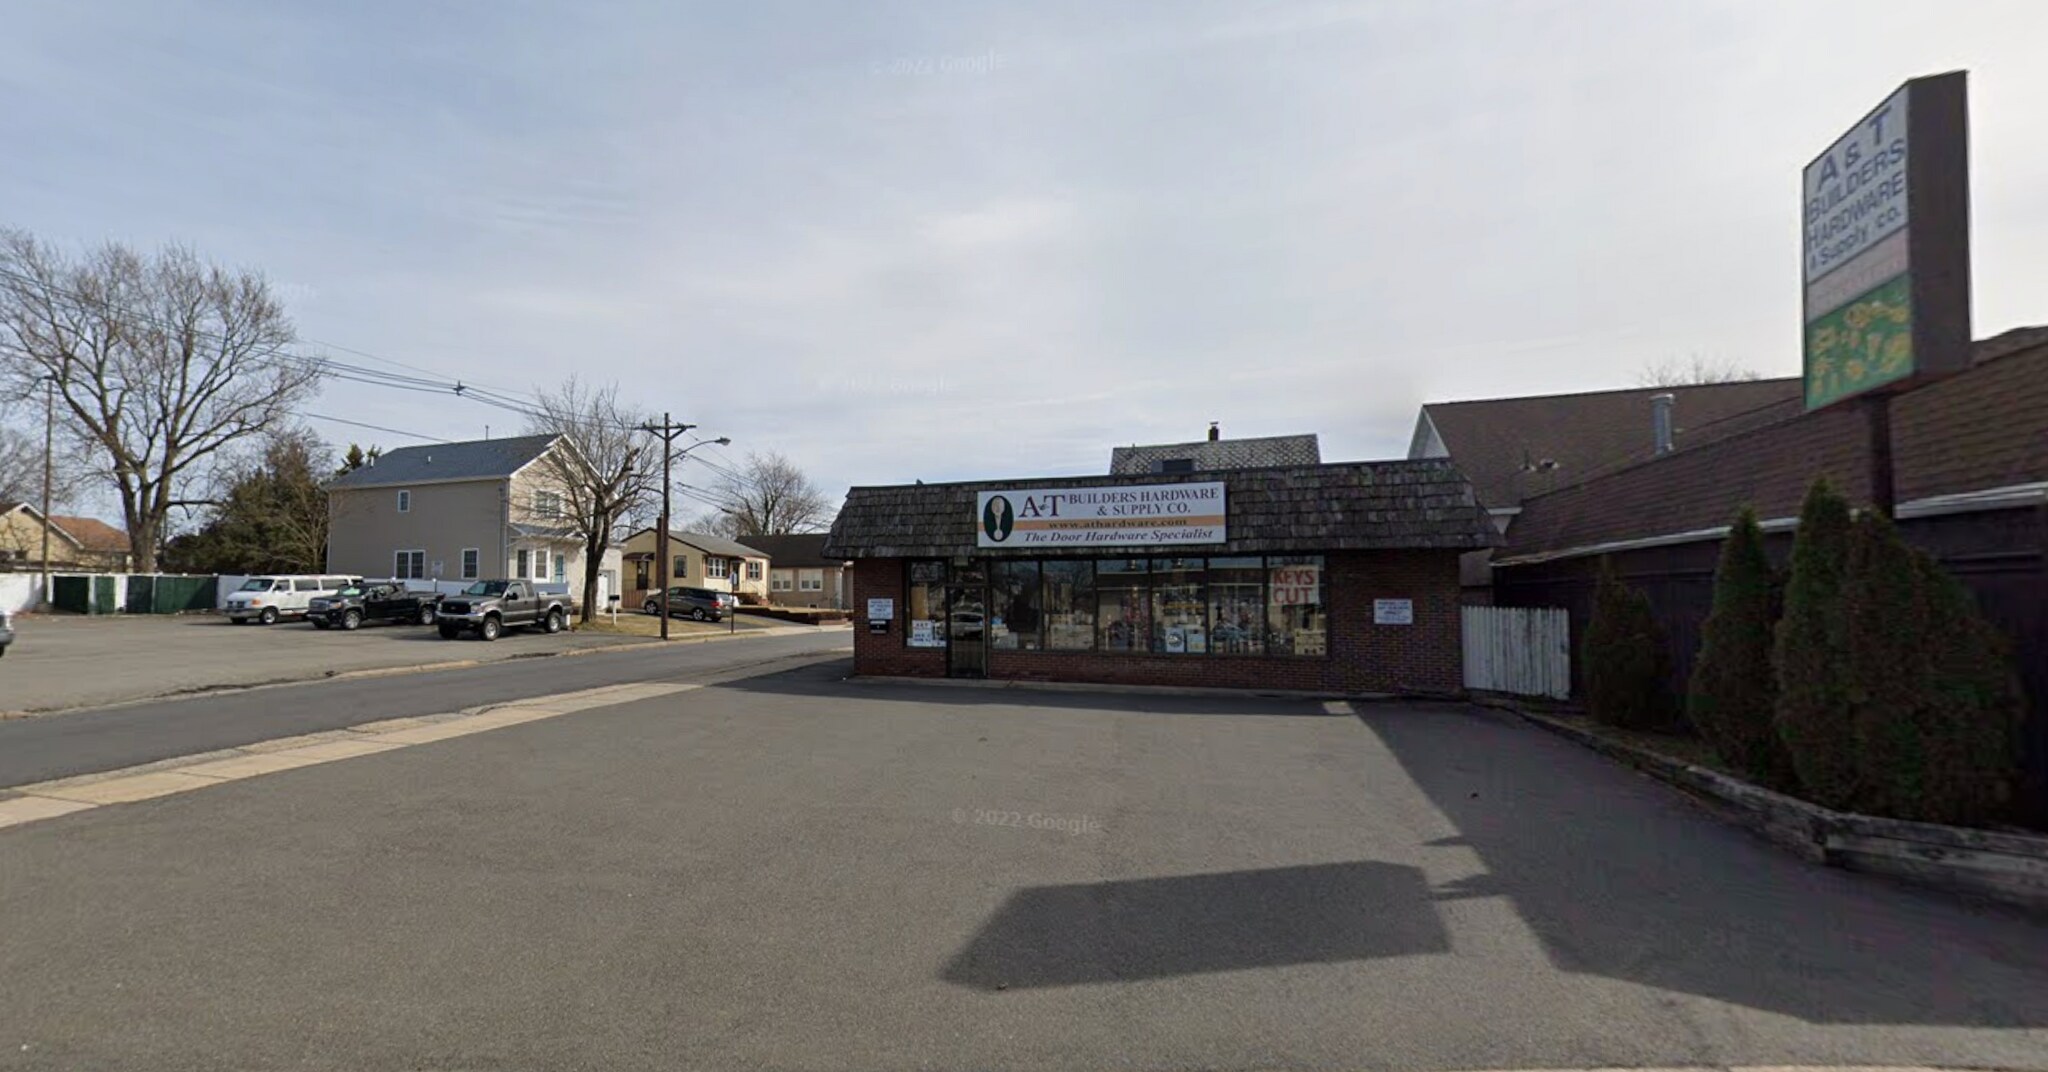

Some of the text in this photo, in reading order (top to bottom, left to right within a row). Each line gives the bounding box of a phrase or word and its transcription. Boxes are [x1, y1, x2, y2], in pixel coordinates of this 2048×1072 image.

[1818, 105, 1892, 192] A & T
[1808, 138, 1905, 224] BUILDERS
[1808, 171, 1904, 253] HARDWARE
[1069, 491, 1137, 505] BUILDERS
[1141, 488, 1219, 502] HARDWARE
[1096, 502, 1191, 516] & SUPPLY CO.
[1048, 519, 1187, 529] www.athardware.com
[1025, 528, 1214, 542] The Door Hardware Specialist
[1273, 569, 1314, 585] KEYS
[1273, 587, 1312, 604] CUT
